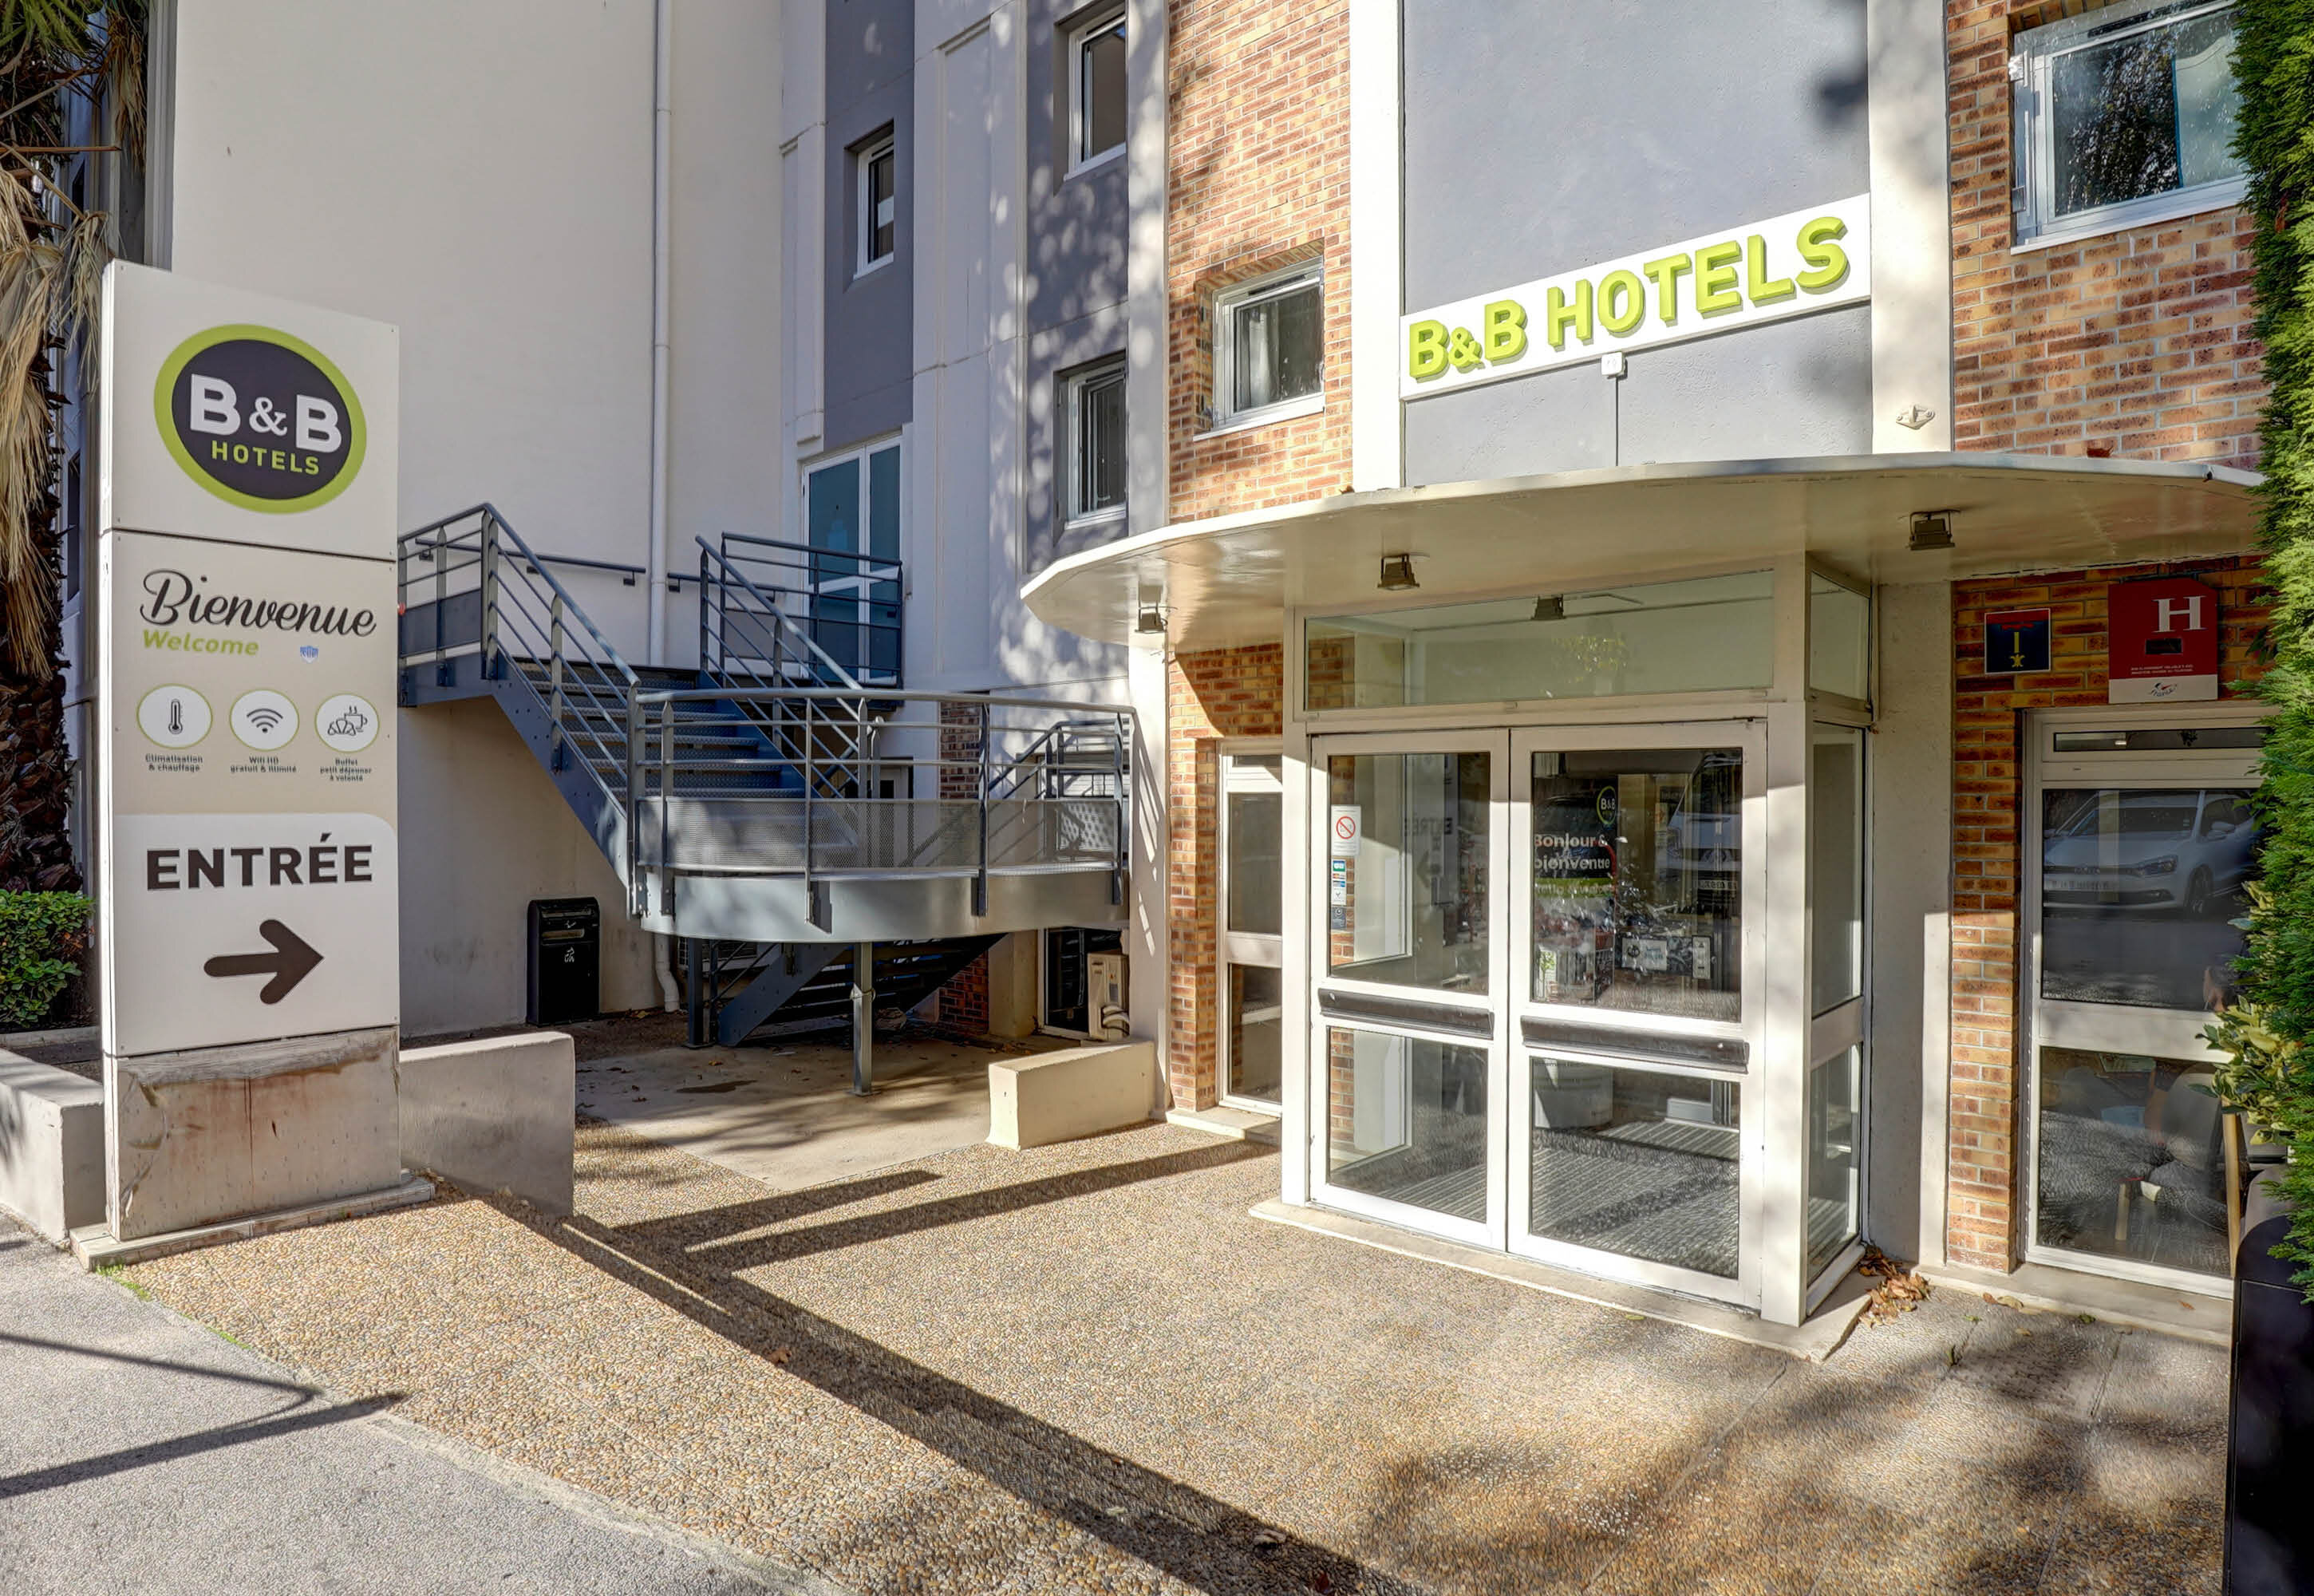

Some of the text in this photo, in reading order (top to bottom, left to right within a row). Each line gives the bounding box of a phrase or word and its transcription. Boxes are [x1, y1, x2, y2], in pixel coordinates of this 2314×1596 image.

[1409, 215, 1850, 383] B&B HOTELS
[211, 440, 320, 476] HOTELS
[140, 569, 377, 637] Bienvenue
[2151, 595, 2208, 633] H
[142, 629, 259, 656] Welcome
[146, 832, 373, 891] ENTRÉE
